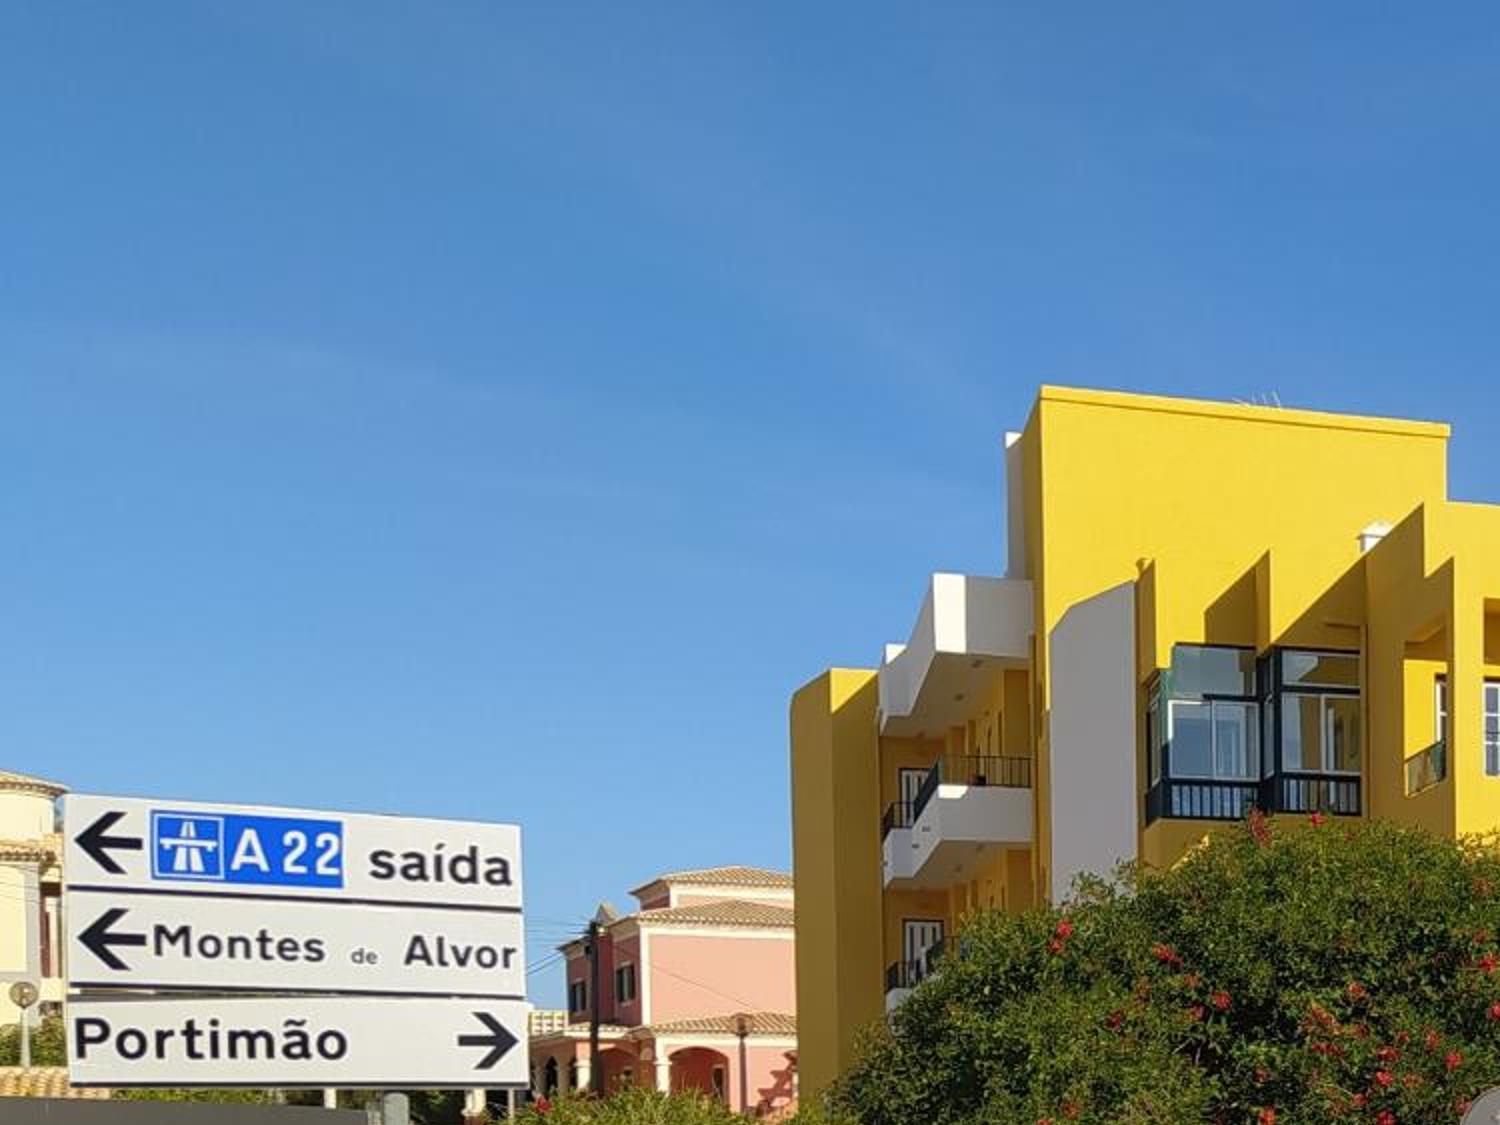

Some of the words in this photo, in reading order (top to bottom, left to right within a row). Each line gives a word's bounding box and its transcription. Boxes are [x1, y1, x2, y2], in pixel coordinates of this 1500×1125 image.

[231, 827, 269, 872] A
[283, 830, 341, 877] 22
[369, 842, 513, 887] saída
[153, 924, 325, 963] Montes
[351, 947, 378, 966] de
[404, 935, 517, 969] Alvor
[75, 1017, 347, 1061] Portimão
